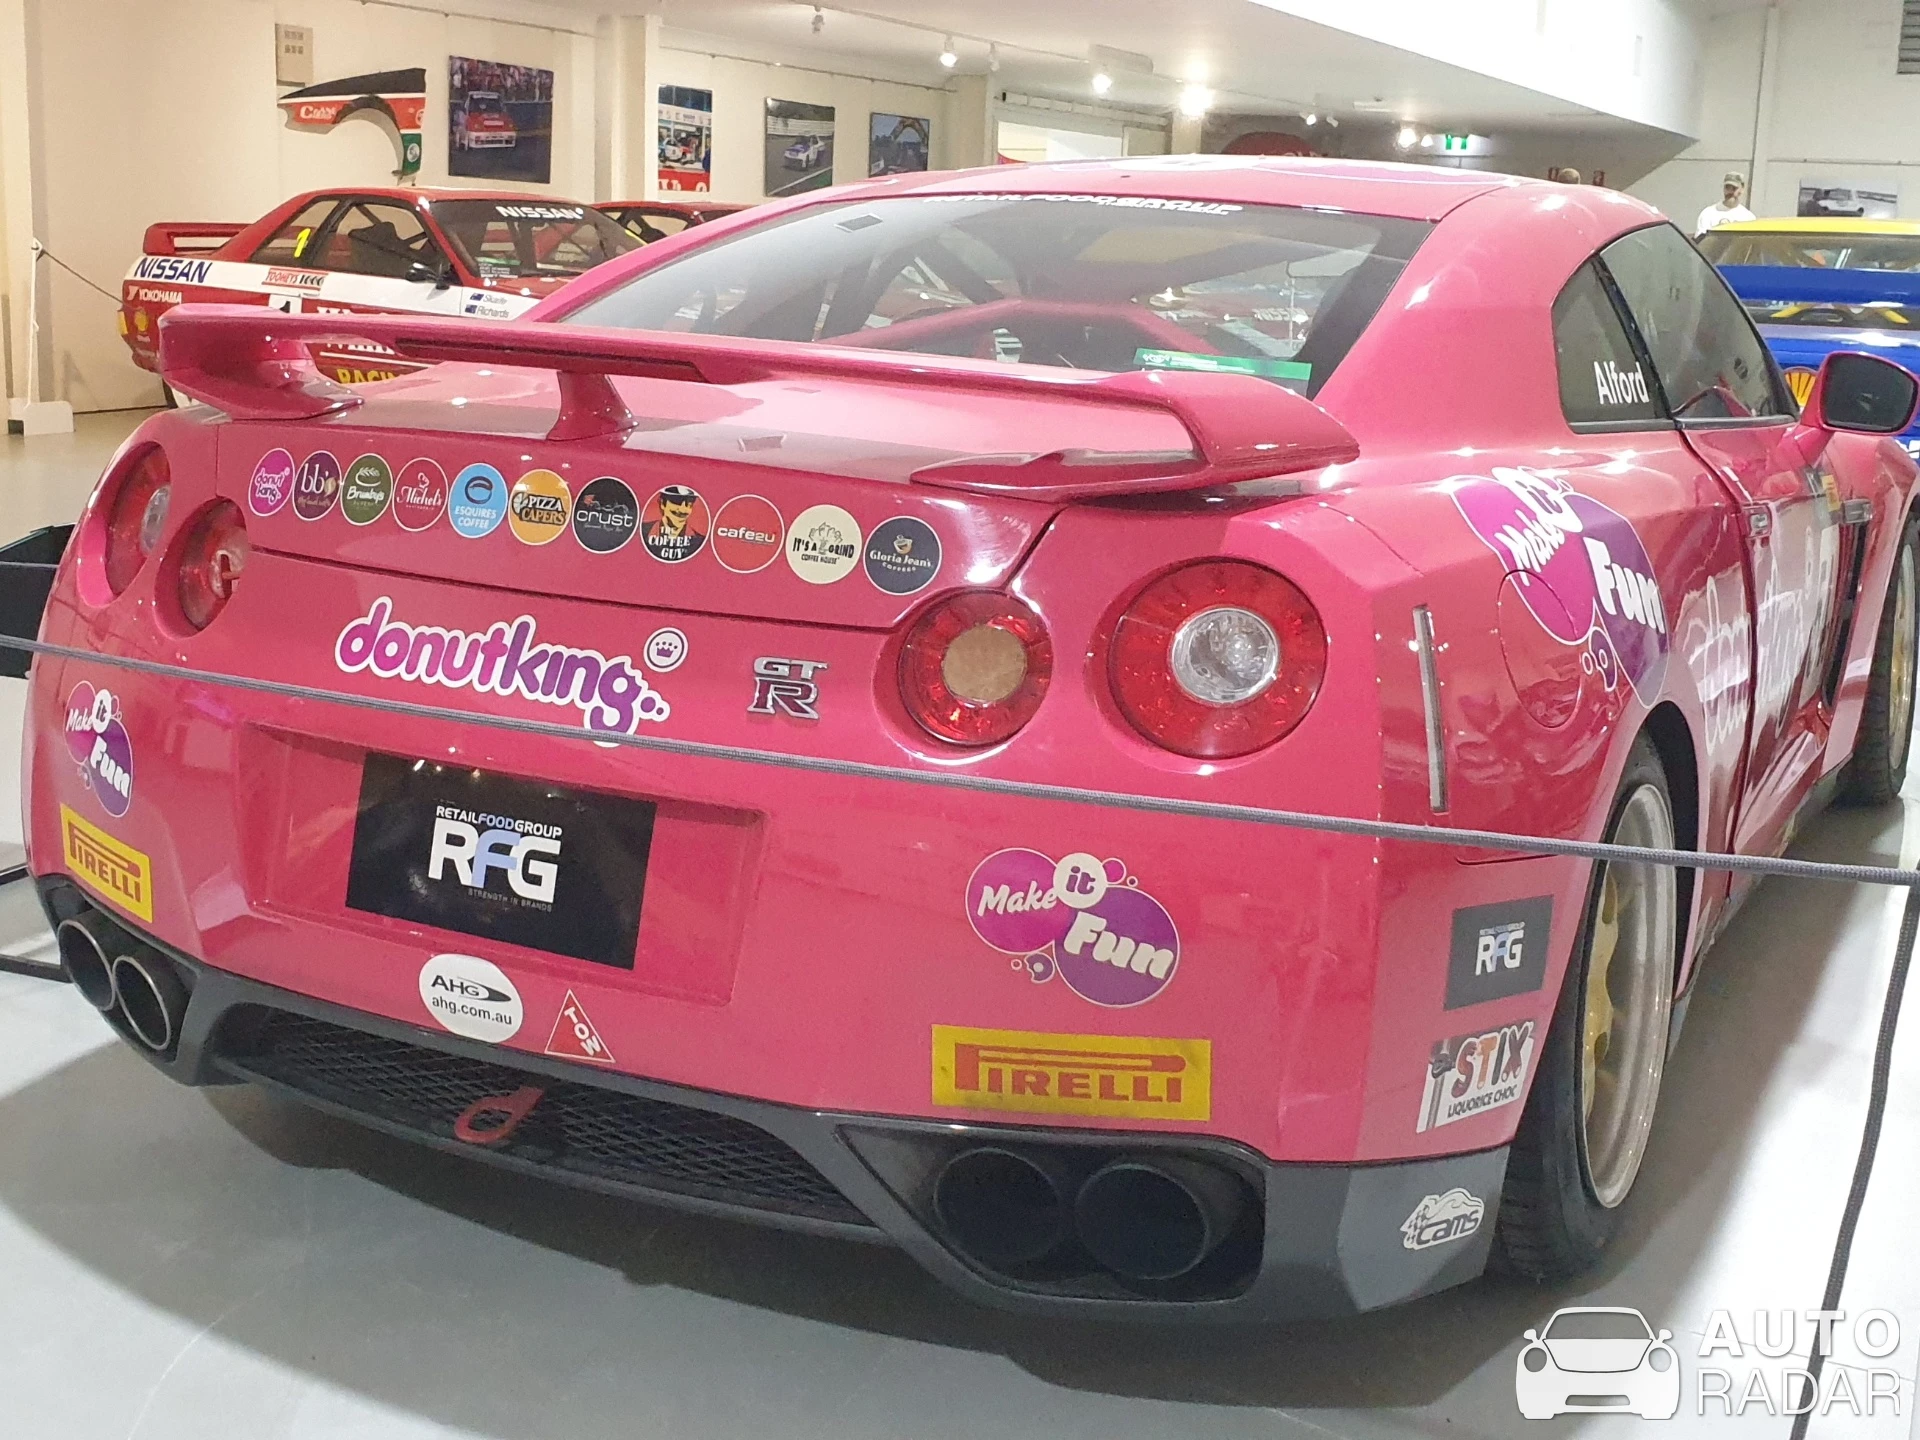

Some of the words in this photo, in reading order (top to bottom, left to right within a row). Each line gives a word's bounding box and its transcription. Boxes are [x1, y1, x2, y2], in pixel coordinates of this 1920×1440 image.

[495, 206, 583, 220] NISSAN
[134, 256, 213, 284] NISSAN
[265, 271, 299, 285] TOOHEYS
[138, 288, 183, 304] YOKOHAMA
[476, 305, 510, 319] Richards
[1593, 360, 1650, 405] Alford
[254, 467, 285, 488] donut
[454, 505, 498, 520] ESQUIRES
[521, 507, 566, 524] CAPERS
[528, 495, 563, 512] PIZZA
[458, 517, 491, 530] COFFEE
[576, 510, 634, 528] crust
[648, 534, 692, 547] COFFEE
[792, 537, 810, 552] IT'S
[811, 542, 817, 552] A
[828, 544, 855, 559] GRIND
[1493, 509, 1566, 587] Make
[660, 547, 684, 560] GUY
[801, 553, 819, 563] COFFEE
[869, 549, 902, 564] Gloria
[1582, 536, 1667, 634] Fun
[752, 657, 829, 680] GT
[97, 699, 108, 724] it
[746, 678, 822, 721] R
[66, 708, 94, 732] Make
[90, 735, 131, 798] Fun
[436, 805, 563, 839] RETAILFOODGROUP
[68, 820, 142, 904] PIRELLI
[427, 817, 562, 904] RFG
[1065, 865, 1096, 895] it
[467, 887, 508, 902] STRENGTH
[520, 897, 553, 913] BRANDS
[976, 880, 1058, 917] Make
[1063, 911, 1174, 979] Fun
[1475, 929, 1525, 976] RFG
[430, 974, 481, 998] AHG
[431, 995, 513, 1026] ahg.com.au
[563, 1006, 602, 1056] TOW
[954, 1041, 1188, 1104] PIRELLI
[1450, 1021, 1535, 1099] STIX
[1446, 1090, 1494, 1119] LIQUORICE
